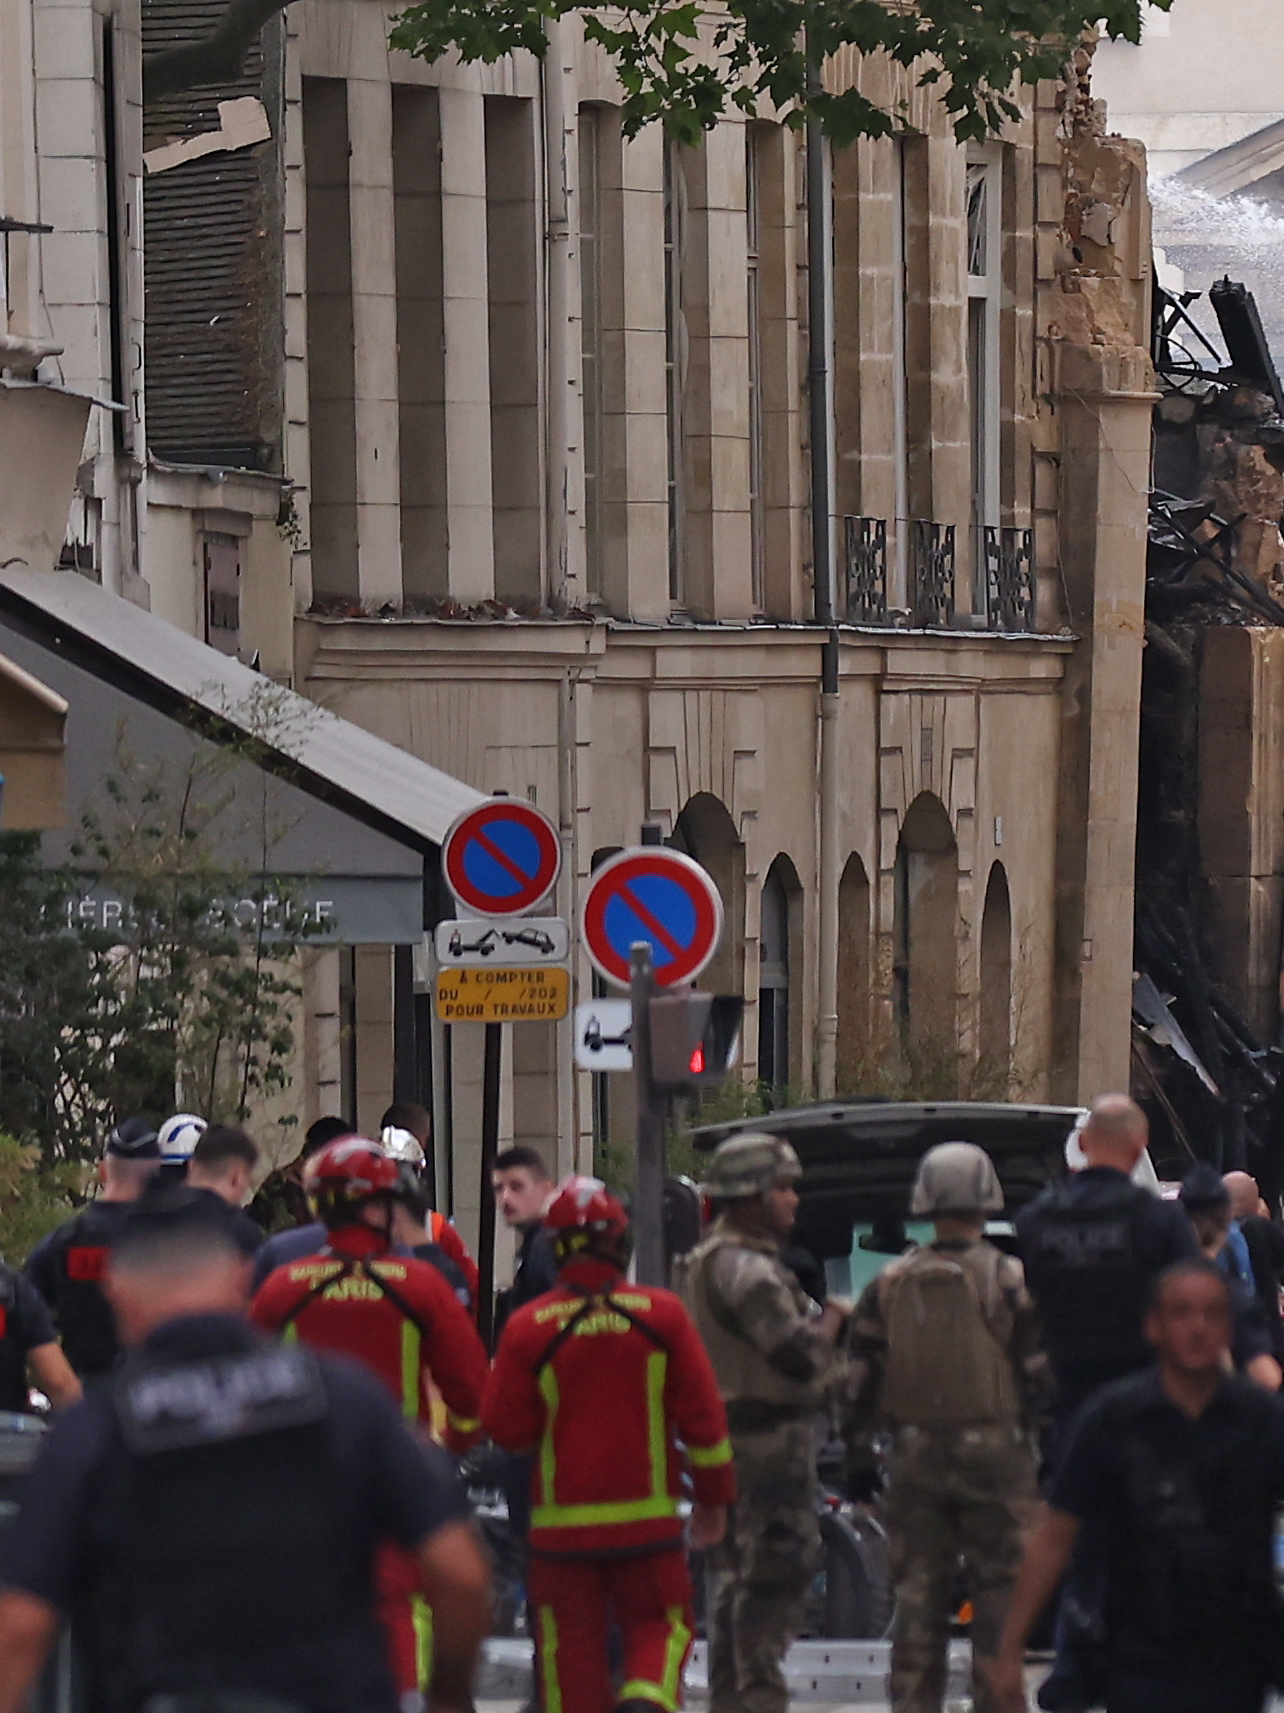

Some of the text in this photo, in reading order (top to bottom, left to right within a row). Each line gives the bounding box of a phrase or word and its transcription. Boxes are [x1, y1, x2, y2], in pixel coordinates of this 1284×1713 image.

[475, 971, 545, 984] COMPTER
[439, 989, 459, 1002] DU
[446, 1003, 556, 1017] POUR TRAVAUX
